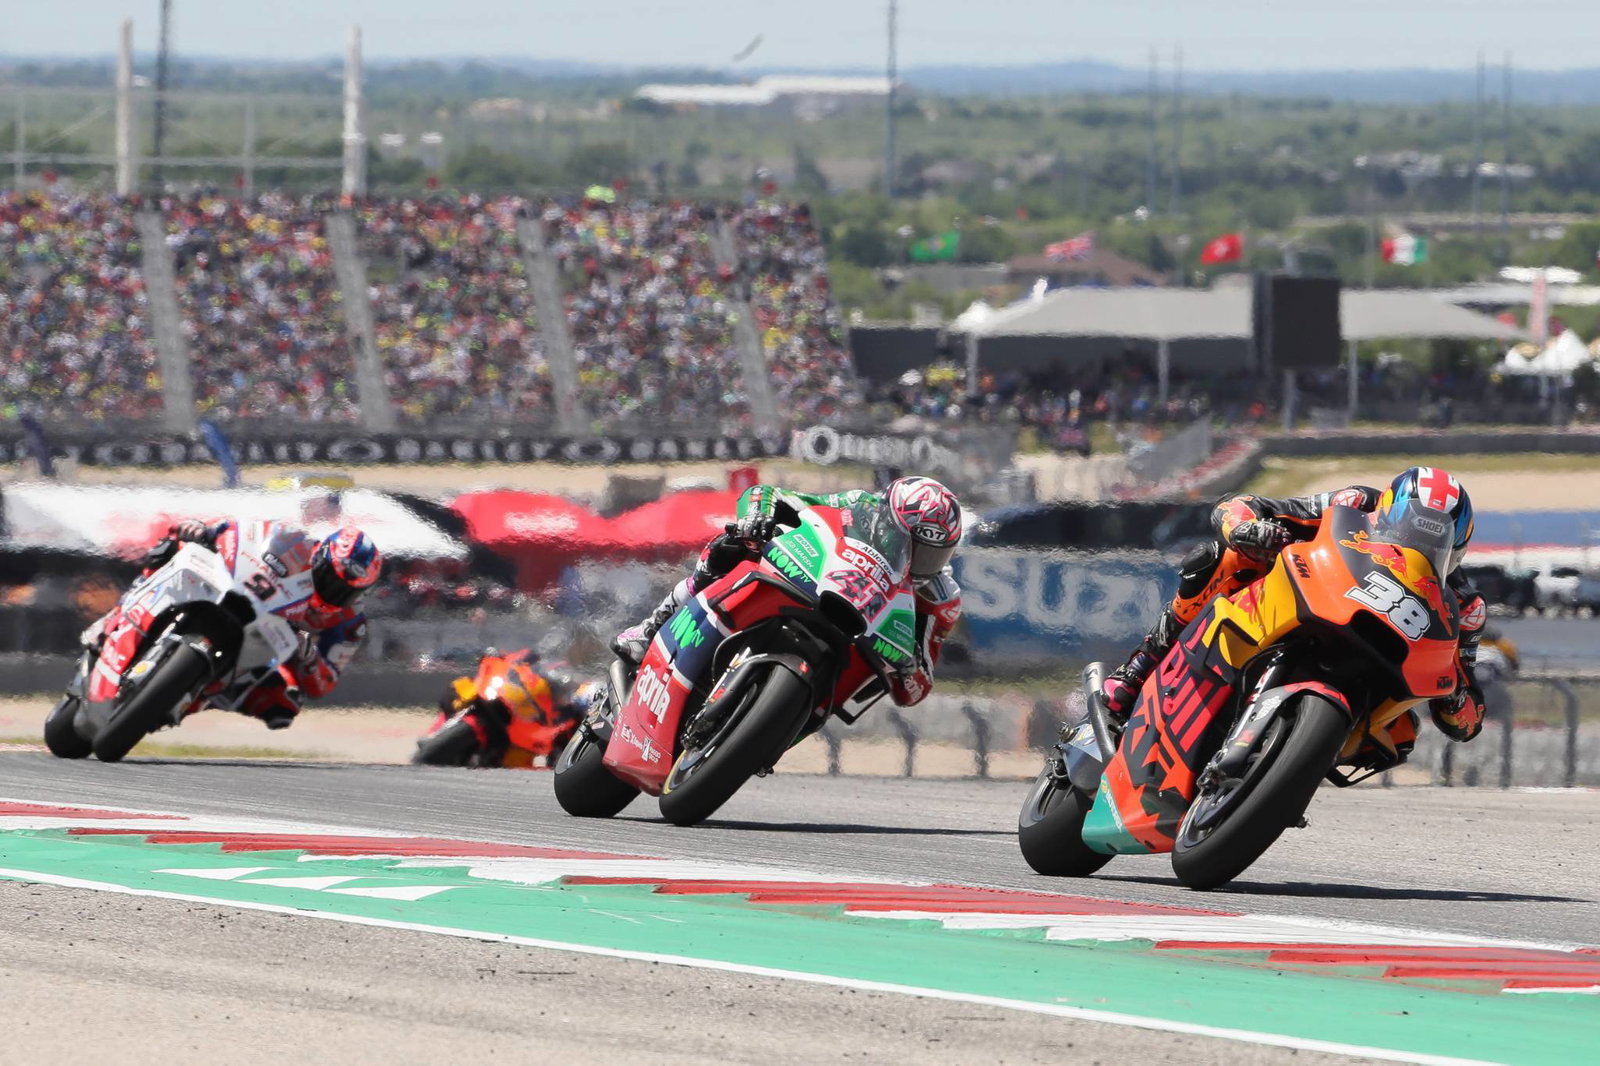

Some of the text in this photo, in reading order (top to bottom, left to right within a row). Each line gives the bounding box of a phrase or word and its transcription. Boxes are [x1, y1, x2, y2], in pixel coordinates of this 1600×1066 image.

[1416, 518, 1443, 534] SHOEI
[767, 546, 803, 578] NOW
[801, 574, 811, 583] TV
[842, 548, 890, 592] aprilia
[1293, 554, 1311, 578] KTM
[1344, 571, 1431, 641] 38
[669, 605, 697, 649] NOW
[873, 638, 903, 662] NOW
[637, 664, 671, 724] aprilia
